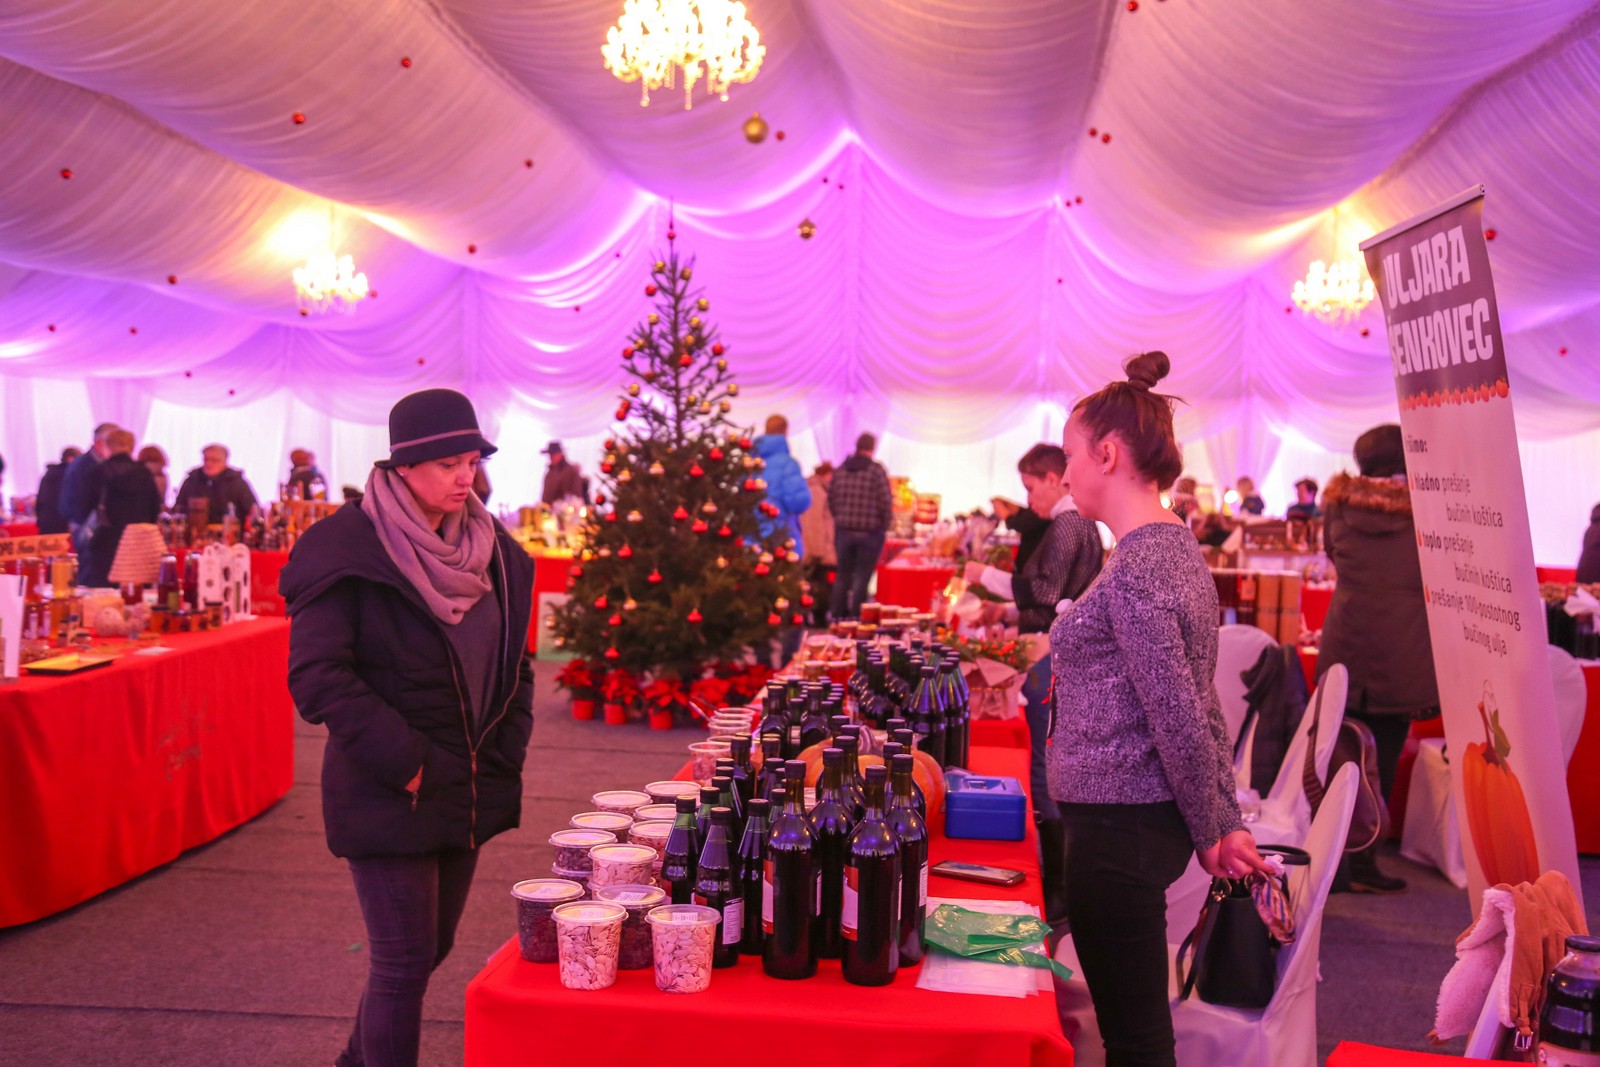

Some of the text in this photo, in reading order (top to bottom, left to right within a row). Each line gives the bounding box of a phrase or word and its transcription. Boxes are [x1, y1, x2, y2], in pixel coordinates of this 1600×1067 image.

[1383, 225, 1471, 309] ULJARA
[1414, 472, 1471, 496] hladno prešanje
[1446, 502, 1503, 527] bučinih koštica
[1422, 530, 1474, 558] toplo prešanje
[1455, 561, 1512, 593] bučinih koštica
[1431, 588, 1464, 613] prešanje
